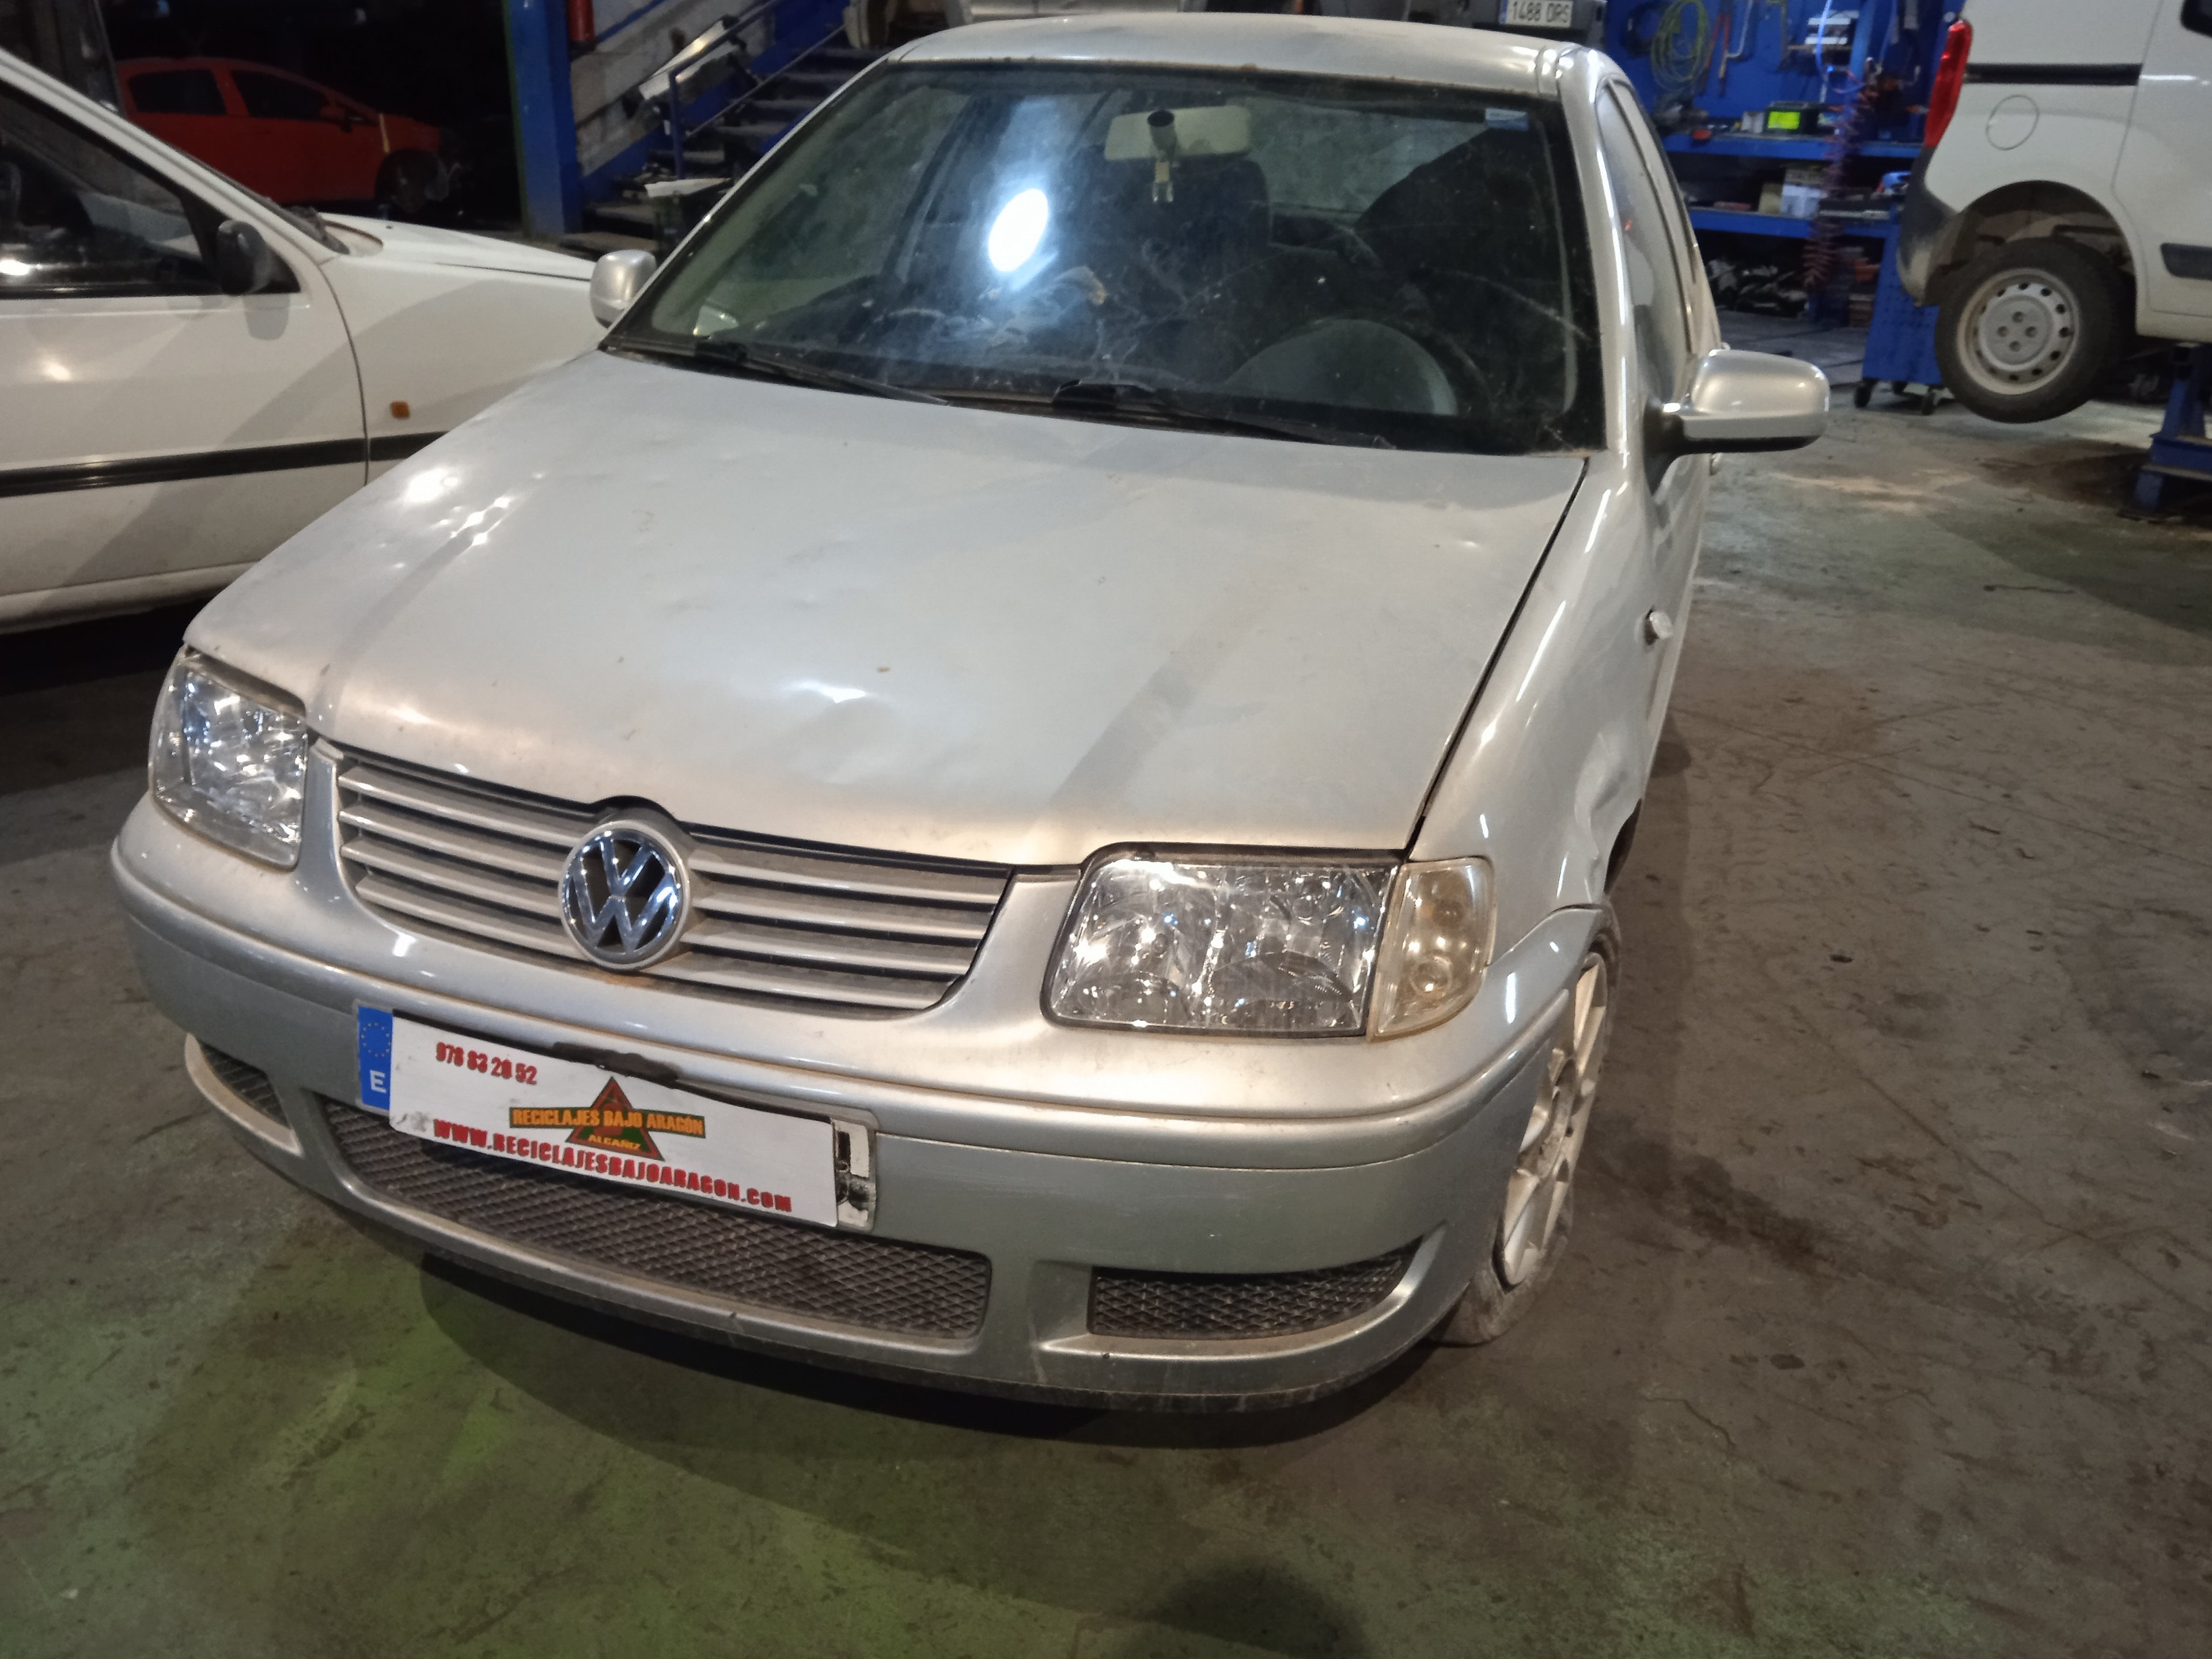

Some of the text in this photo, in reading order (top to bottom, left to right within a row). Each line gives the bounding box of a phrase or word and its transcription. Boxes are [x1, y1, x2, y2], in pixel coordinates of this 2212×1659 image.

[369, 1069, 387, 1094] E
[516, 1062, 537, 1085] 52
[512, 1109, 600, 1127] RECICLAJES
[603, 1110, 643, 1128] BAJO
